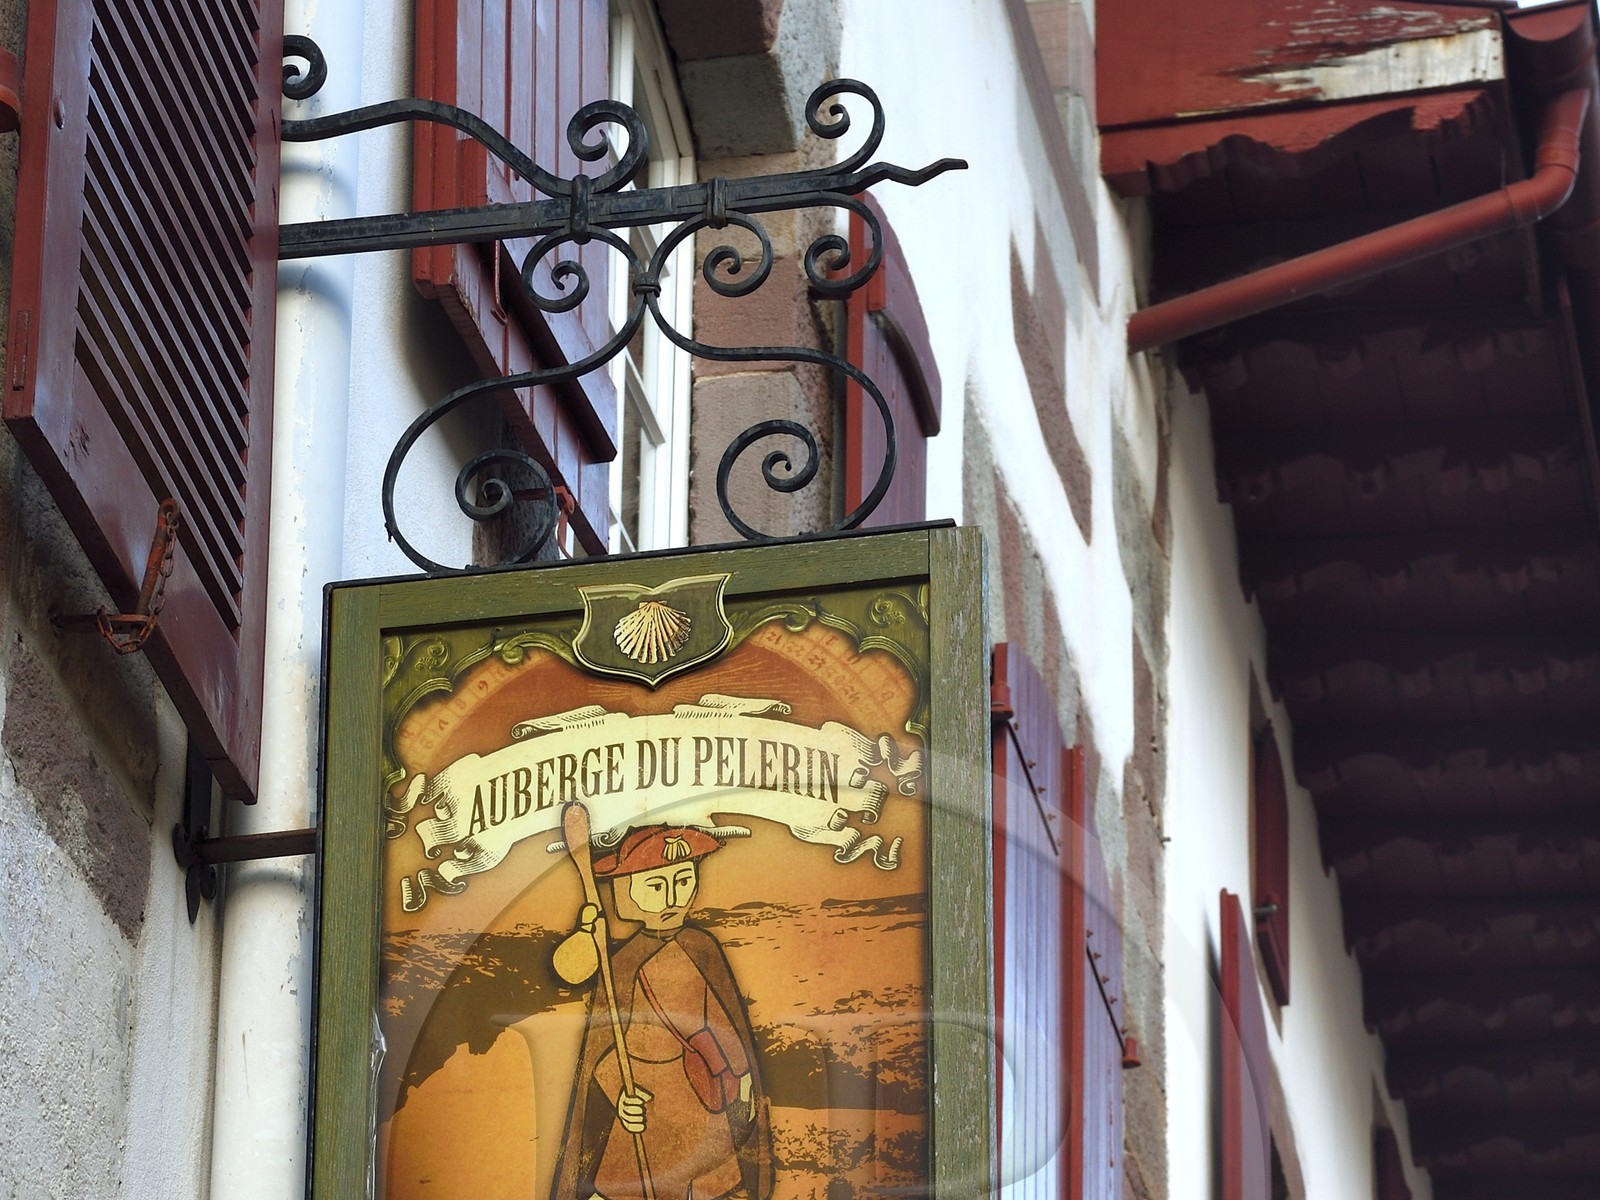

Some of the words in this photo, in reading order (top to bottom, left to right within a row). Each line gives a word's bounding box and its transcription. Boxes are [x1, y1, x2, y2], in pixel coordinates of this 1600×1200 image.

[464, 743, 626, 839] AUBERGE
[635, 737, 682, 791] DU
[691, 736, 842, 804] PELERIN
